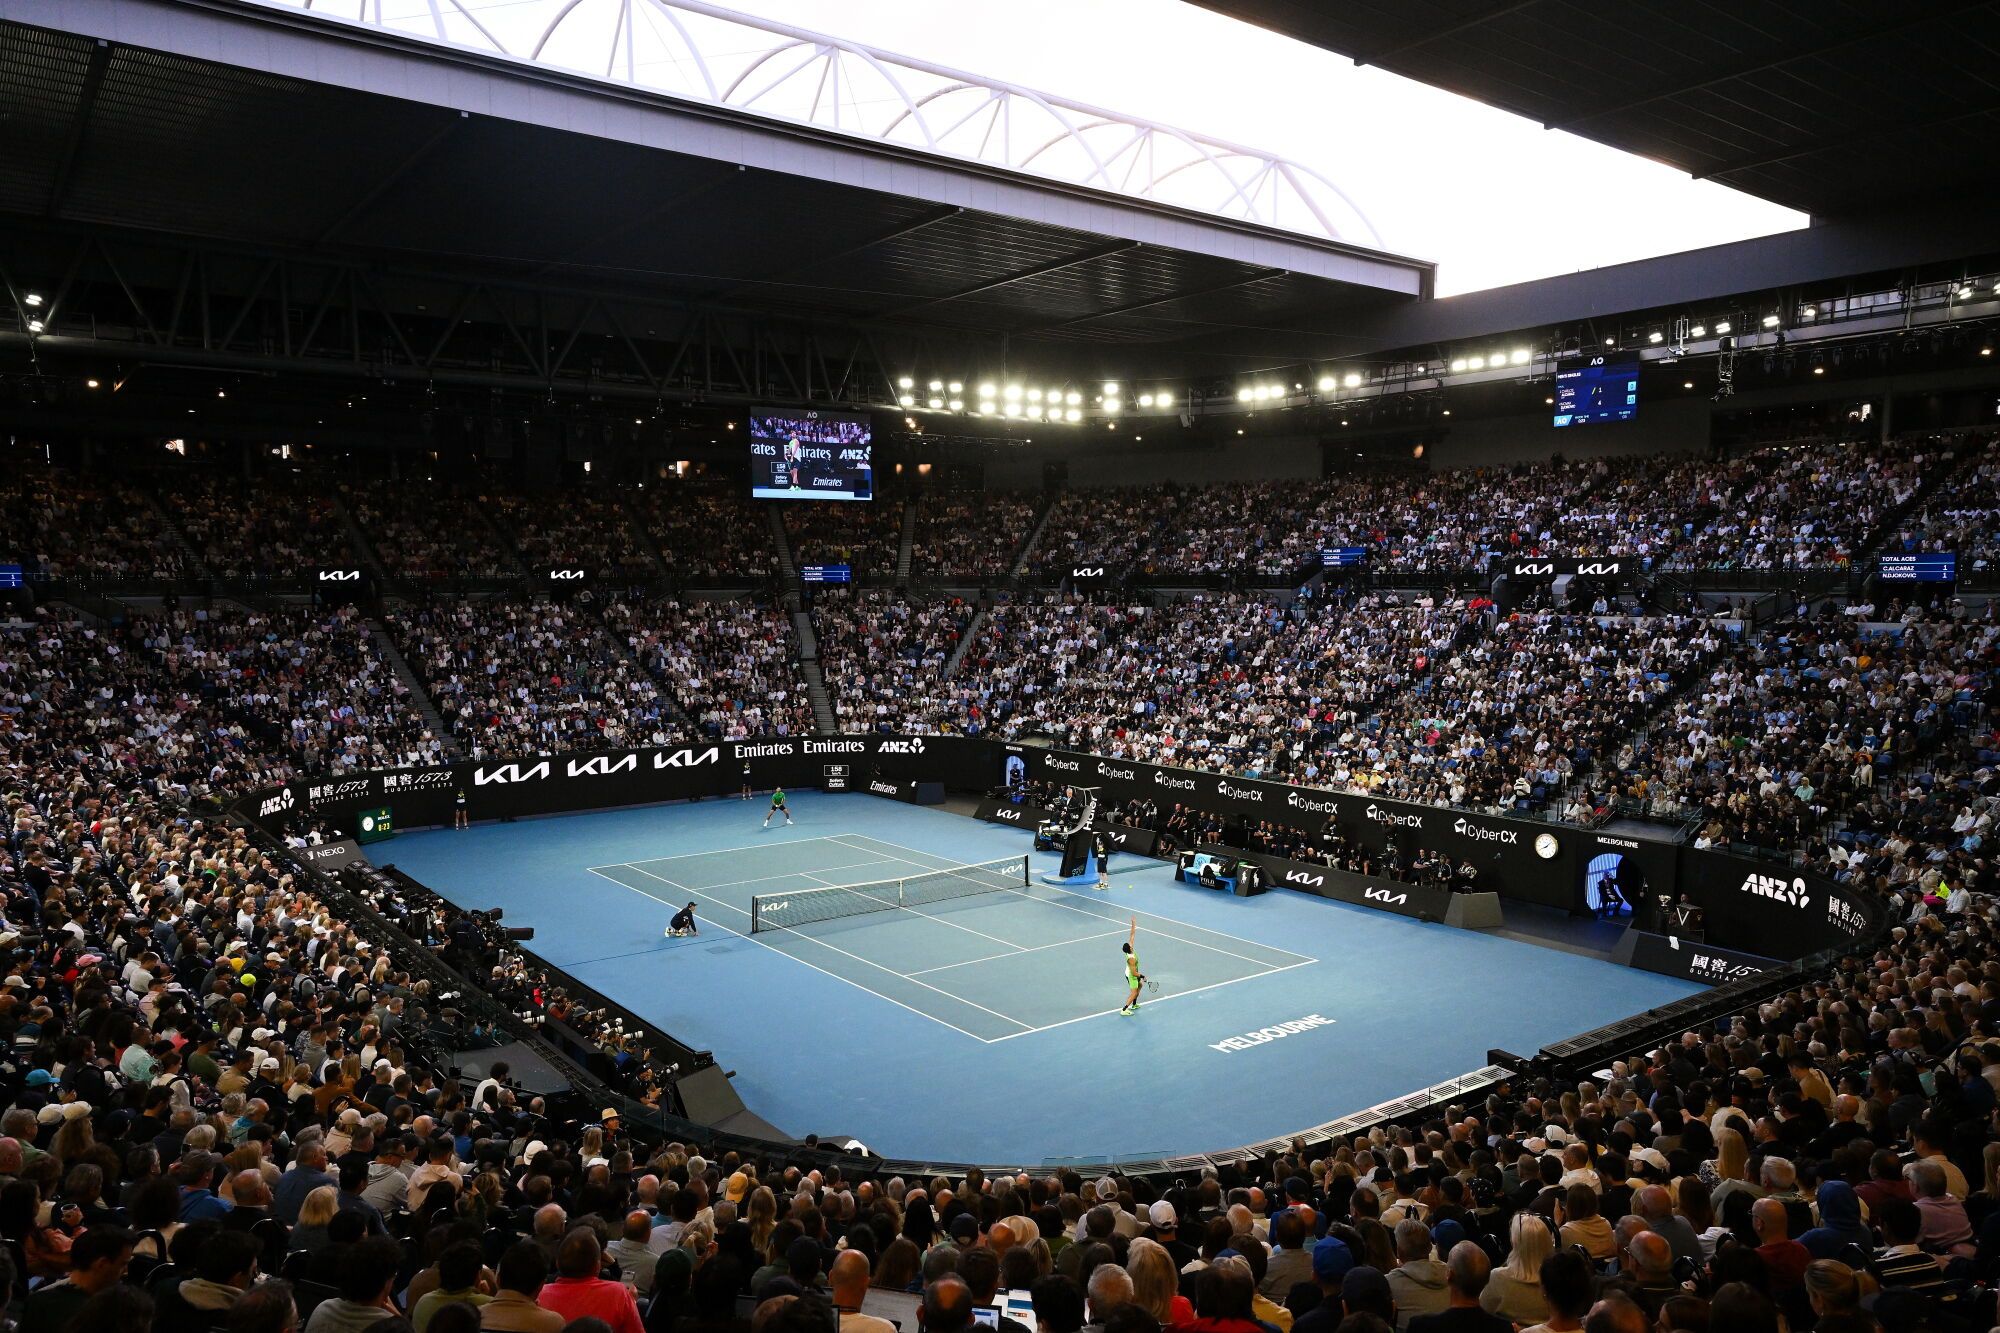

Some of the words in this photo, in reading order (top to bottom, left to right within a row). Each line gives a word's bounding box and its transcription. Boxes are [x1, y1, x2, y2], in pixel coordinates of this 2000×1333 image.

[813, 477, 842, 486] Emirates
[735, 743, 793, 758] Emirates
[803, 739, 864, 753] Emirates
[877, 740, 909, 754] ANZ
[568, 754, 637, 776] KIA
[654, 748, 718, 769] KIA
[1052, 758, 1080, 772] CyberCX
[475, 762, 549, 785] KIA
[1105, 768, 1135, 781] CyberCX
[870, 781, 897, 794] Emirates
[1163, 776, 1196, 790] CyberCX
[1227, 786, 1262, 802] CyberCX
[260, 796, 281, 817] ANZ
[1298, 798, 1338, 814] CyberCX
[997, 809, 1021, 820] KIA
[1467, 826, 1518, 845] CyberCX
[1597, 836, 1639, 848] MELBOURNE
[317, 846, 344, 859] NEXO
[1286, 870, 1324, 886] KIA
[1741, 874, 1787, 902] ANZ
[1365, 887, 1407, 905] KIA
[1207, 1014, 1336, 1054] MELBOURNE
